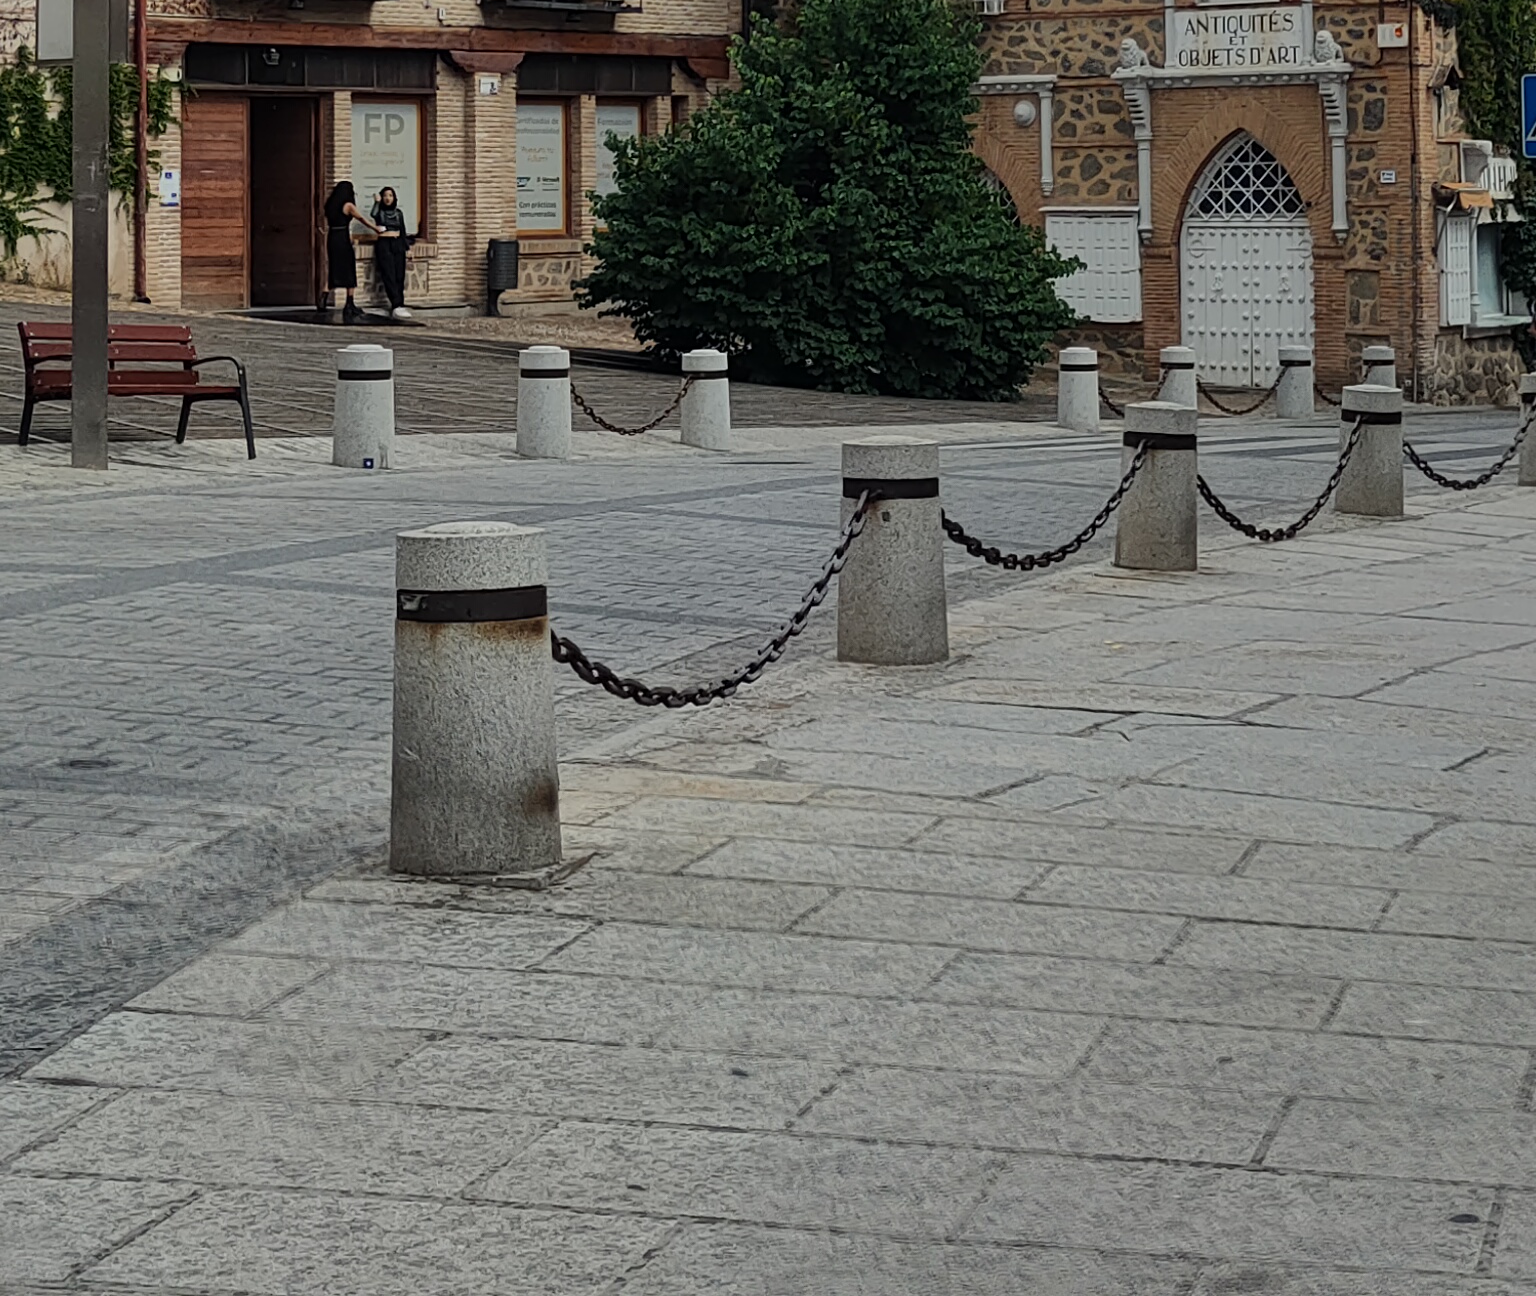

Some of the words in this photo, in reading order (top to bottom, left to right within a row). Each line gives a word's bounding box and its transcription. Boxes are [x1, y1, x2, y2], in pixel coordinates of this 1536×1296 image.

[1184, 10, 1294, 37] ANTIQUITÉS
[1229, 35, 1249, 46] ET
[1178, 47, 1245, 67] OBJETS
[1249, 45, 1301, 65] D'ART
[364, 113, 405, 144] FP
